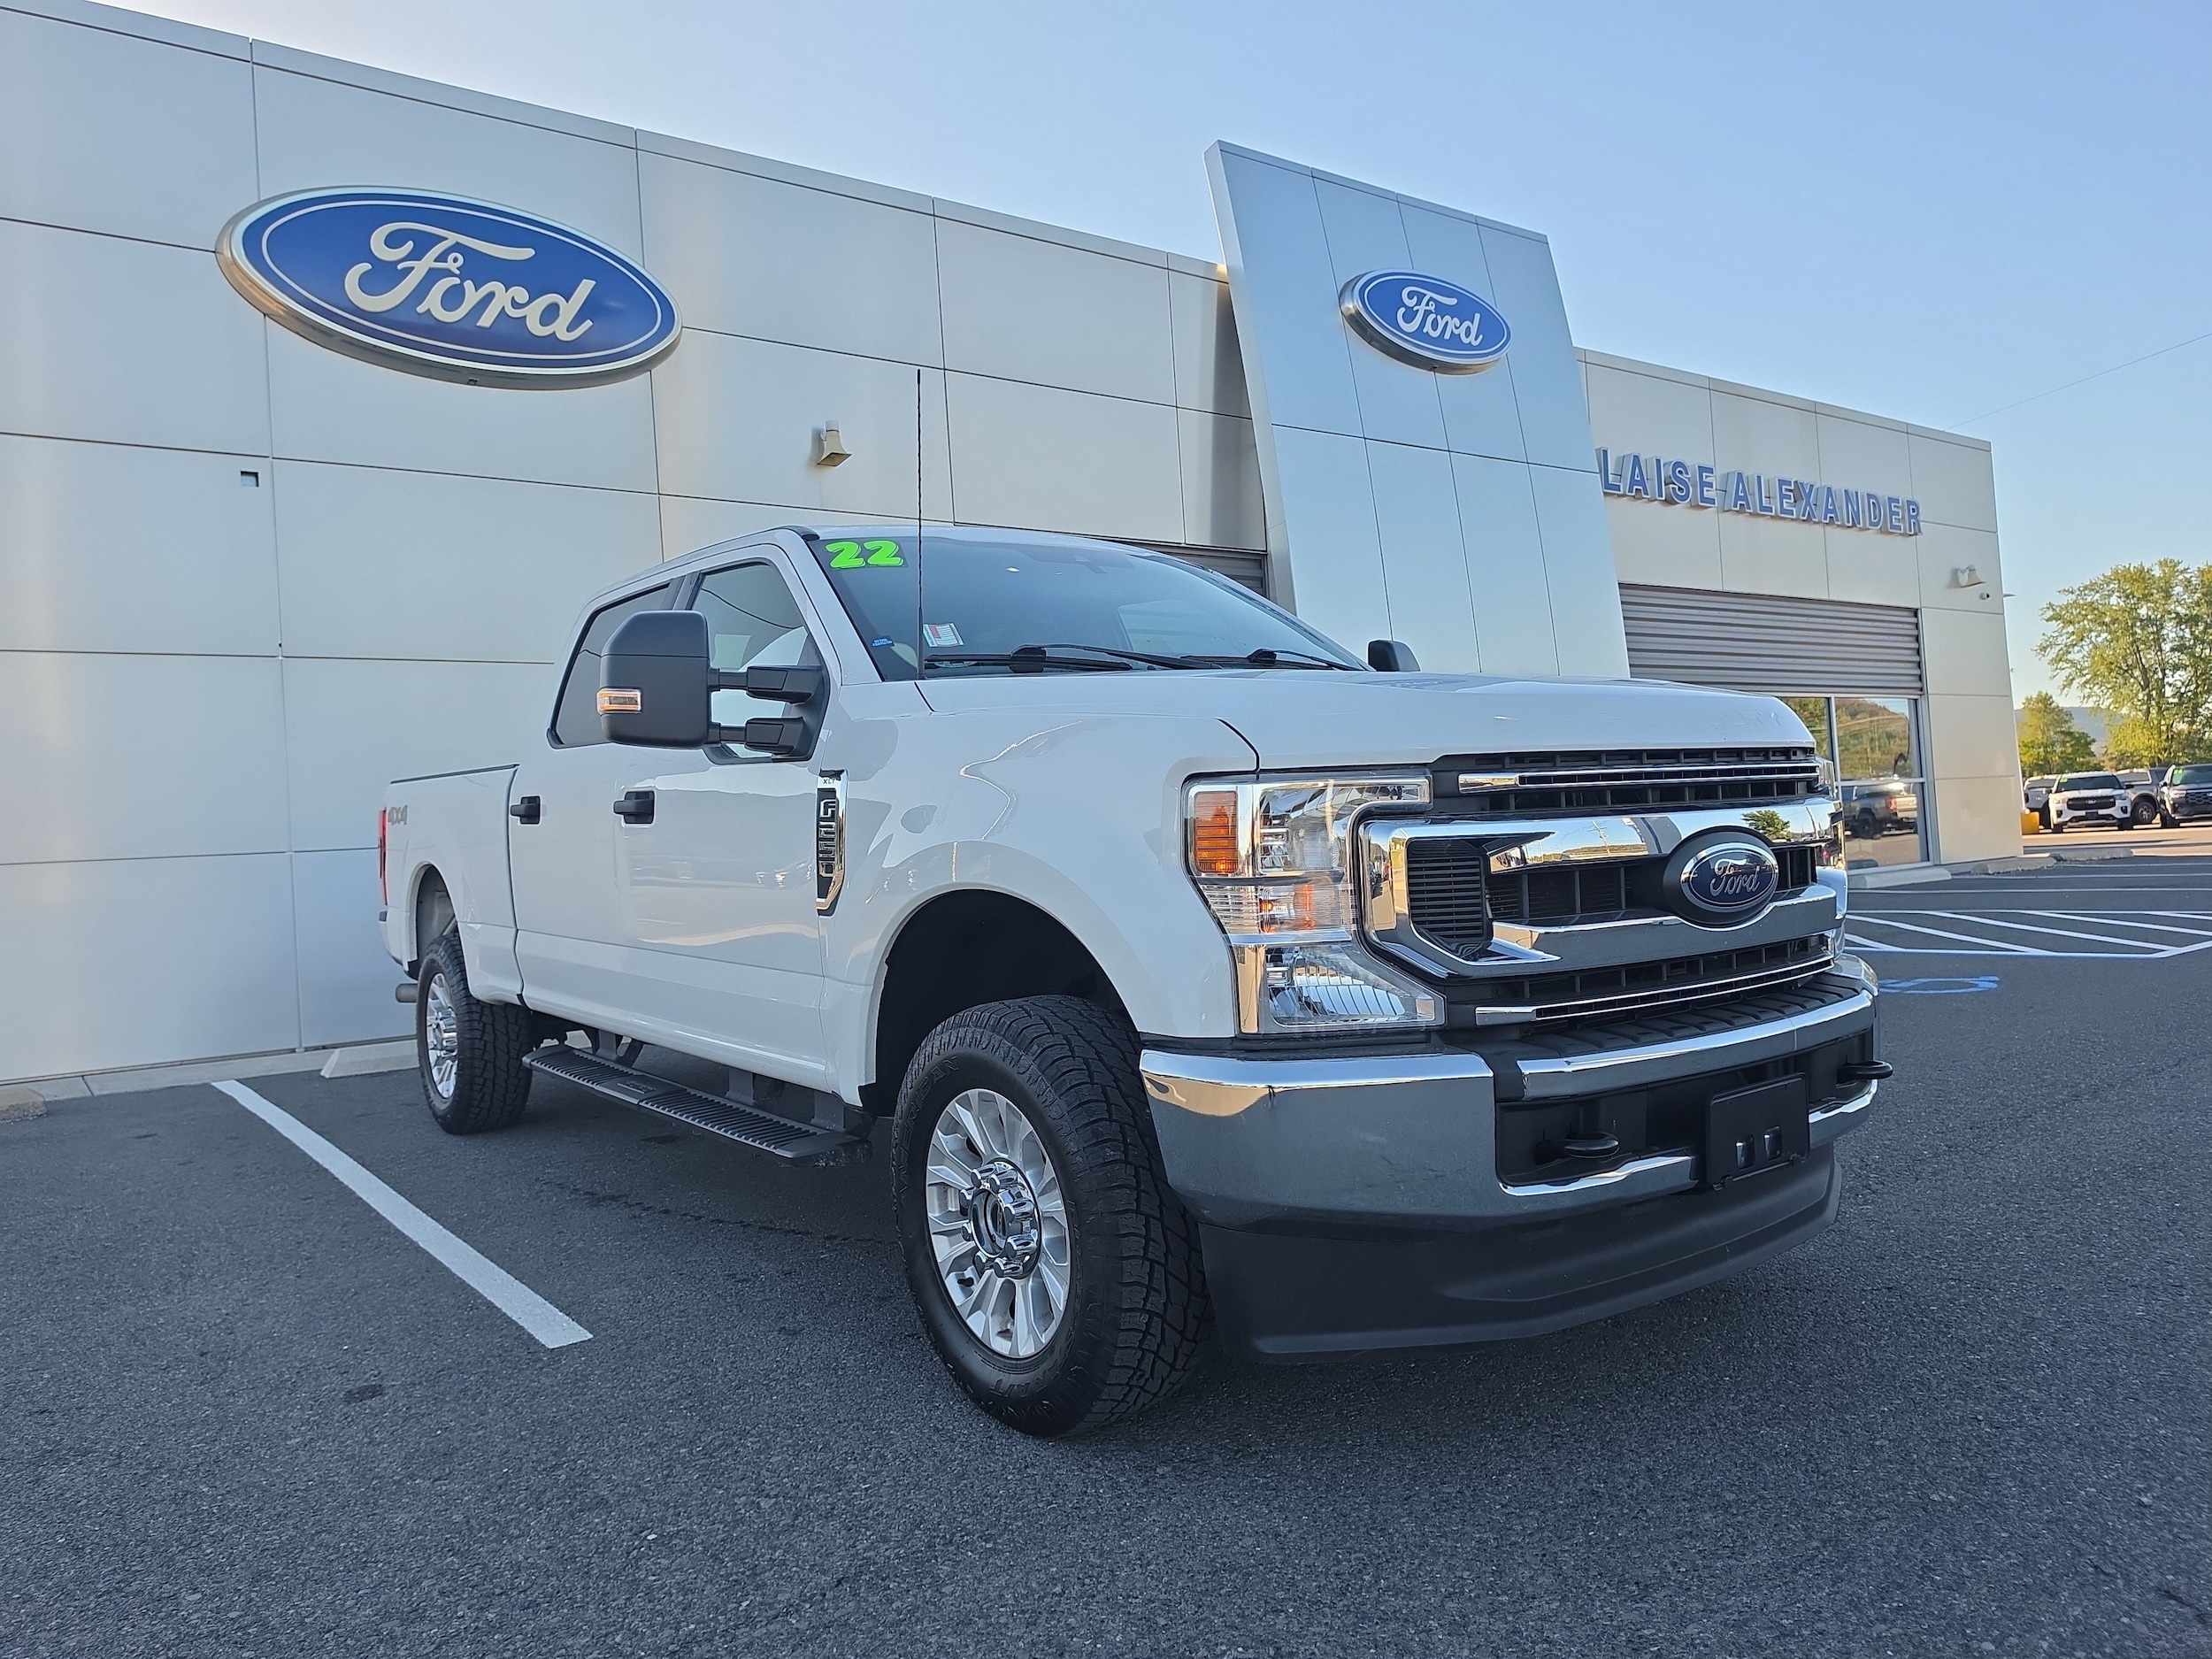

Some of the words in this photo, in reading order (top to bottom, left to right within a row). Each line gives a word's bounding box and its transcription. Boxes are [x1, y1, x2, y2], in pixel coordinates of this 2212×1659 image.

[344, 221, 596, 342] Ford
[1396, 286, 1484, 346] Ford
[1724, 470, 1923, 535] ALEXANDER
[826, 540, 904, 570] 22
[1709, 857, 1761, 897] Ford
